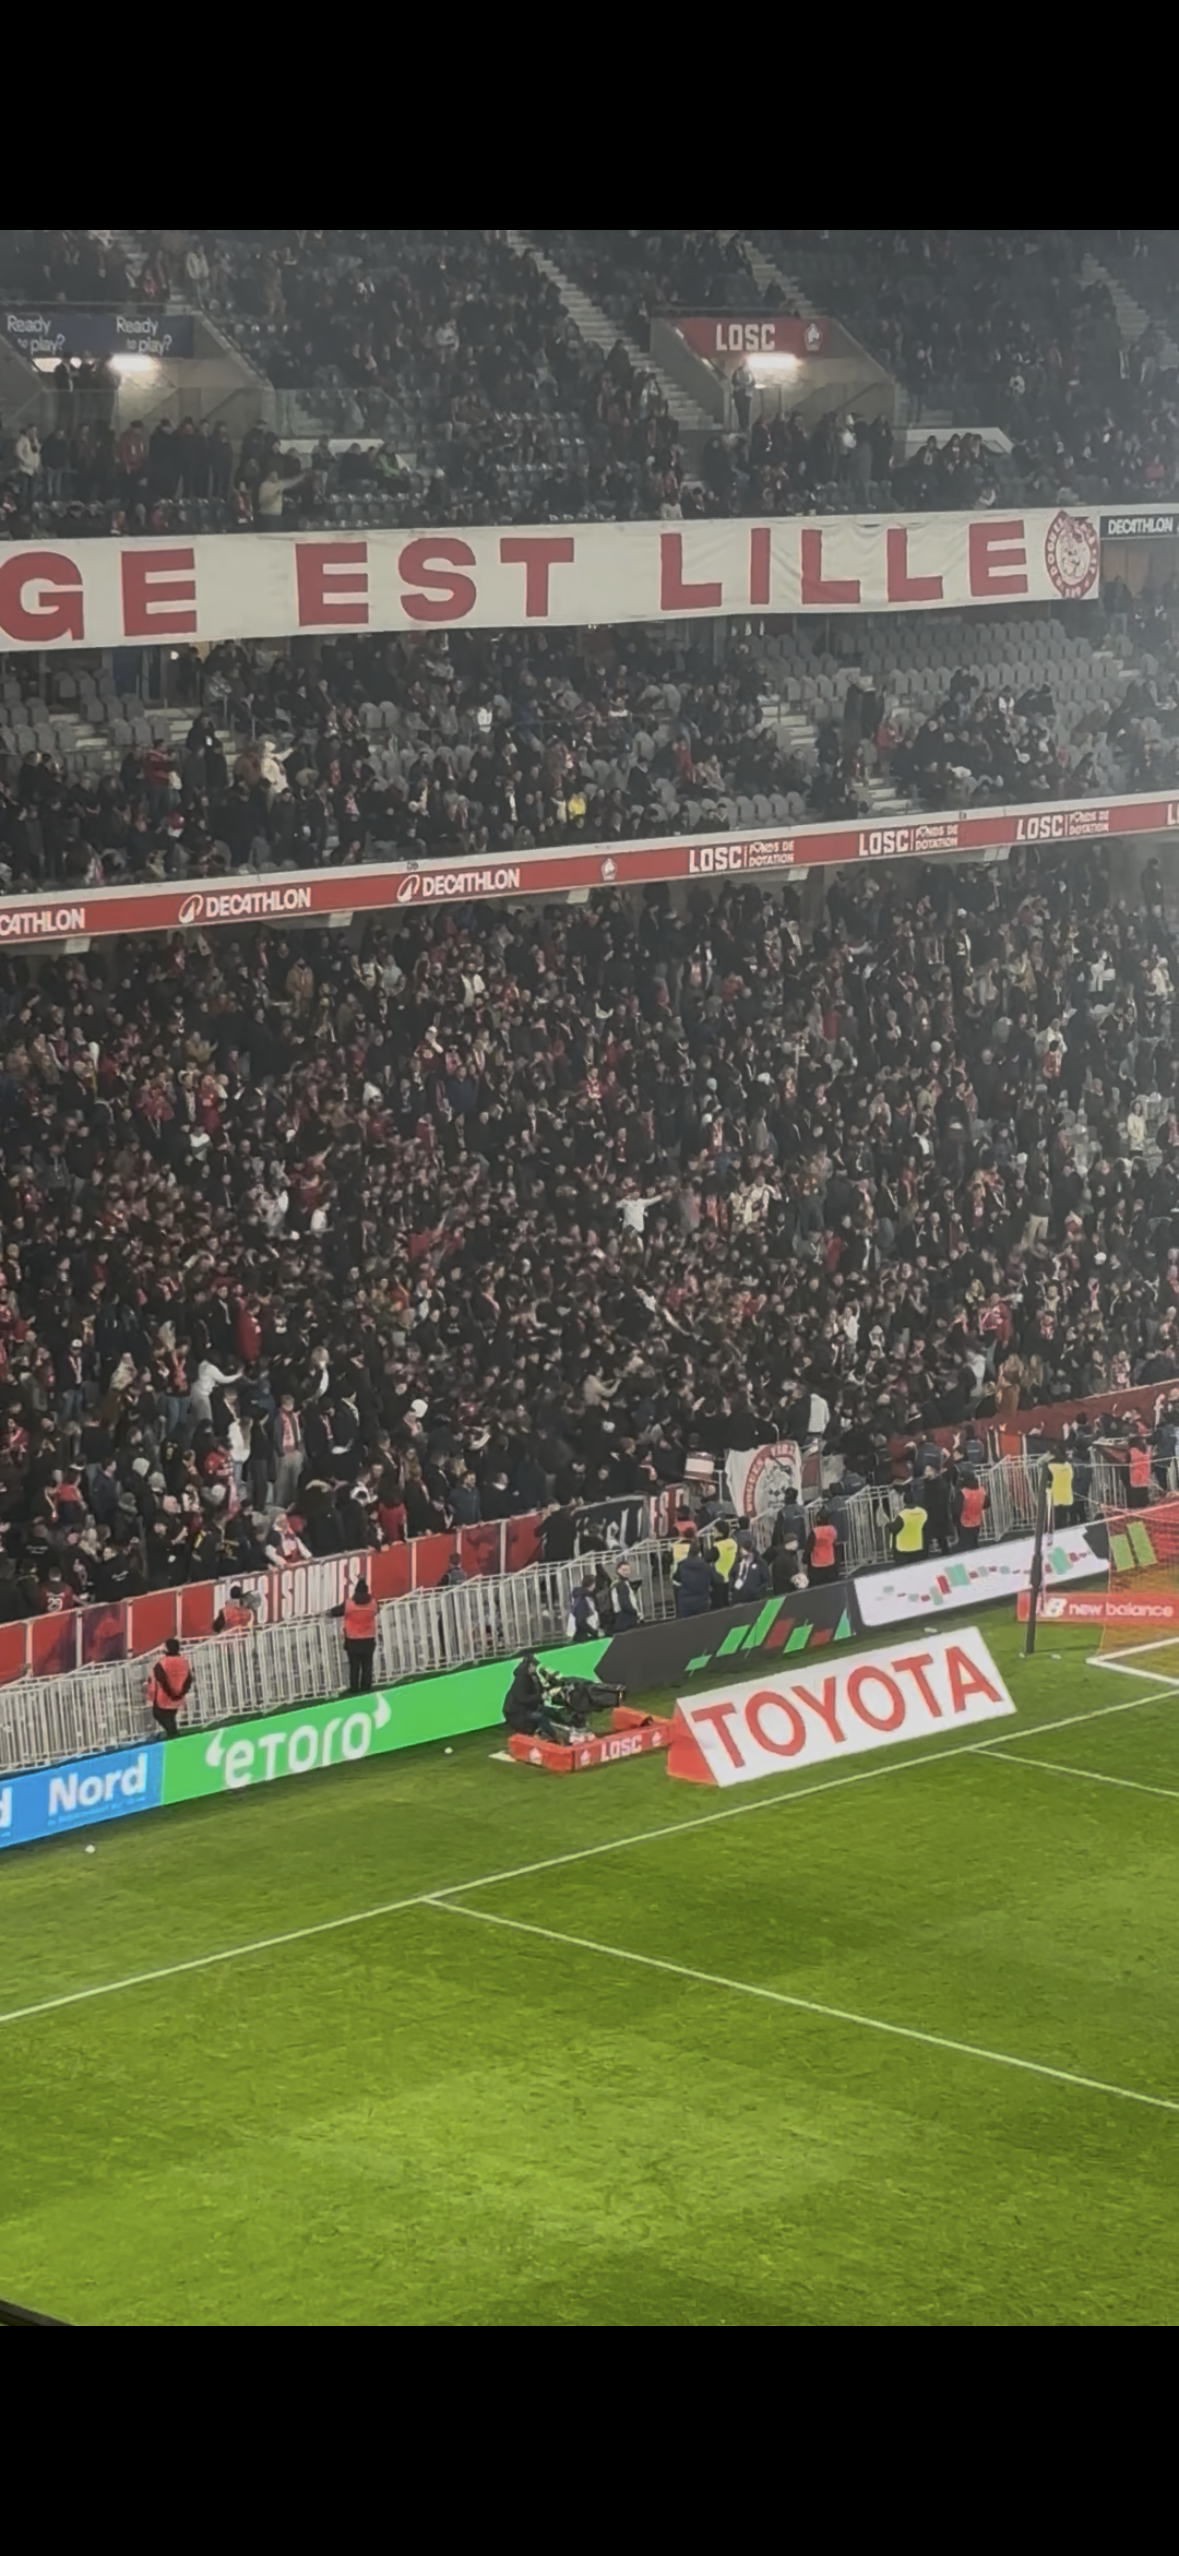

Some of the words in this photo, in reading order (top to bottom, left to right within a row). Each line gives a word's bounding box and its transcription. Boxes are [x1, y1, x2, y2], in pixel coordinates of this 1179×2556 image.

[7, 315, 51, 335] Ready
[116, 316, 159, 336] Ready
[716, 323, 775, 351] LOSC
[30, 333, 66, 355] play?
[138, 334, 173, 356] play?
[1108, 517, 1173, 535] DECATHLON
[295, 537, 574, 627] EST
[660, 519, 1028, 611] LILLE
[1017, 814, 1063, 840] LOSC
[859, 829, 910, 857] LOSC
[688, 845, 743, 873] LOSC
[422, 868, 520, 897] DECATHLON
[206, 887, 311, 918] DECATHLON
[0, 907, 85, 935] CATHLON
[1069, 1603, 1103, 1616] new
[1105, 1600, 1174, 1618] balance
[690, 1646, 1003, 1768] TOYOTA
[600, 1734, 642, 1762] LOSC
[48, 1752, 148, 1816] Nord
